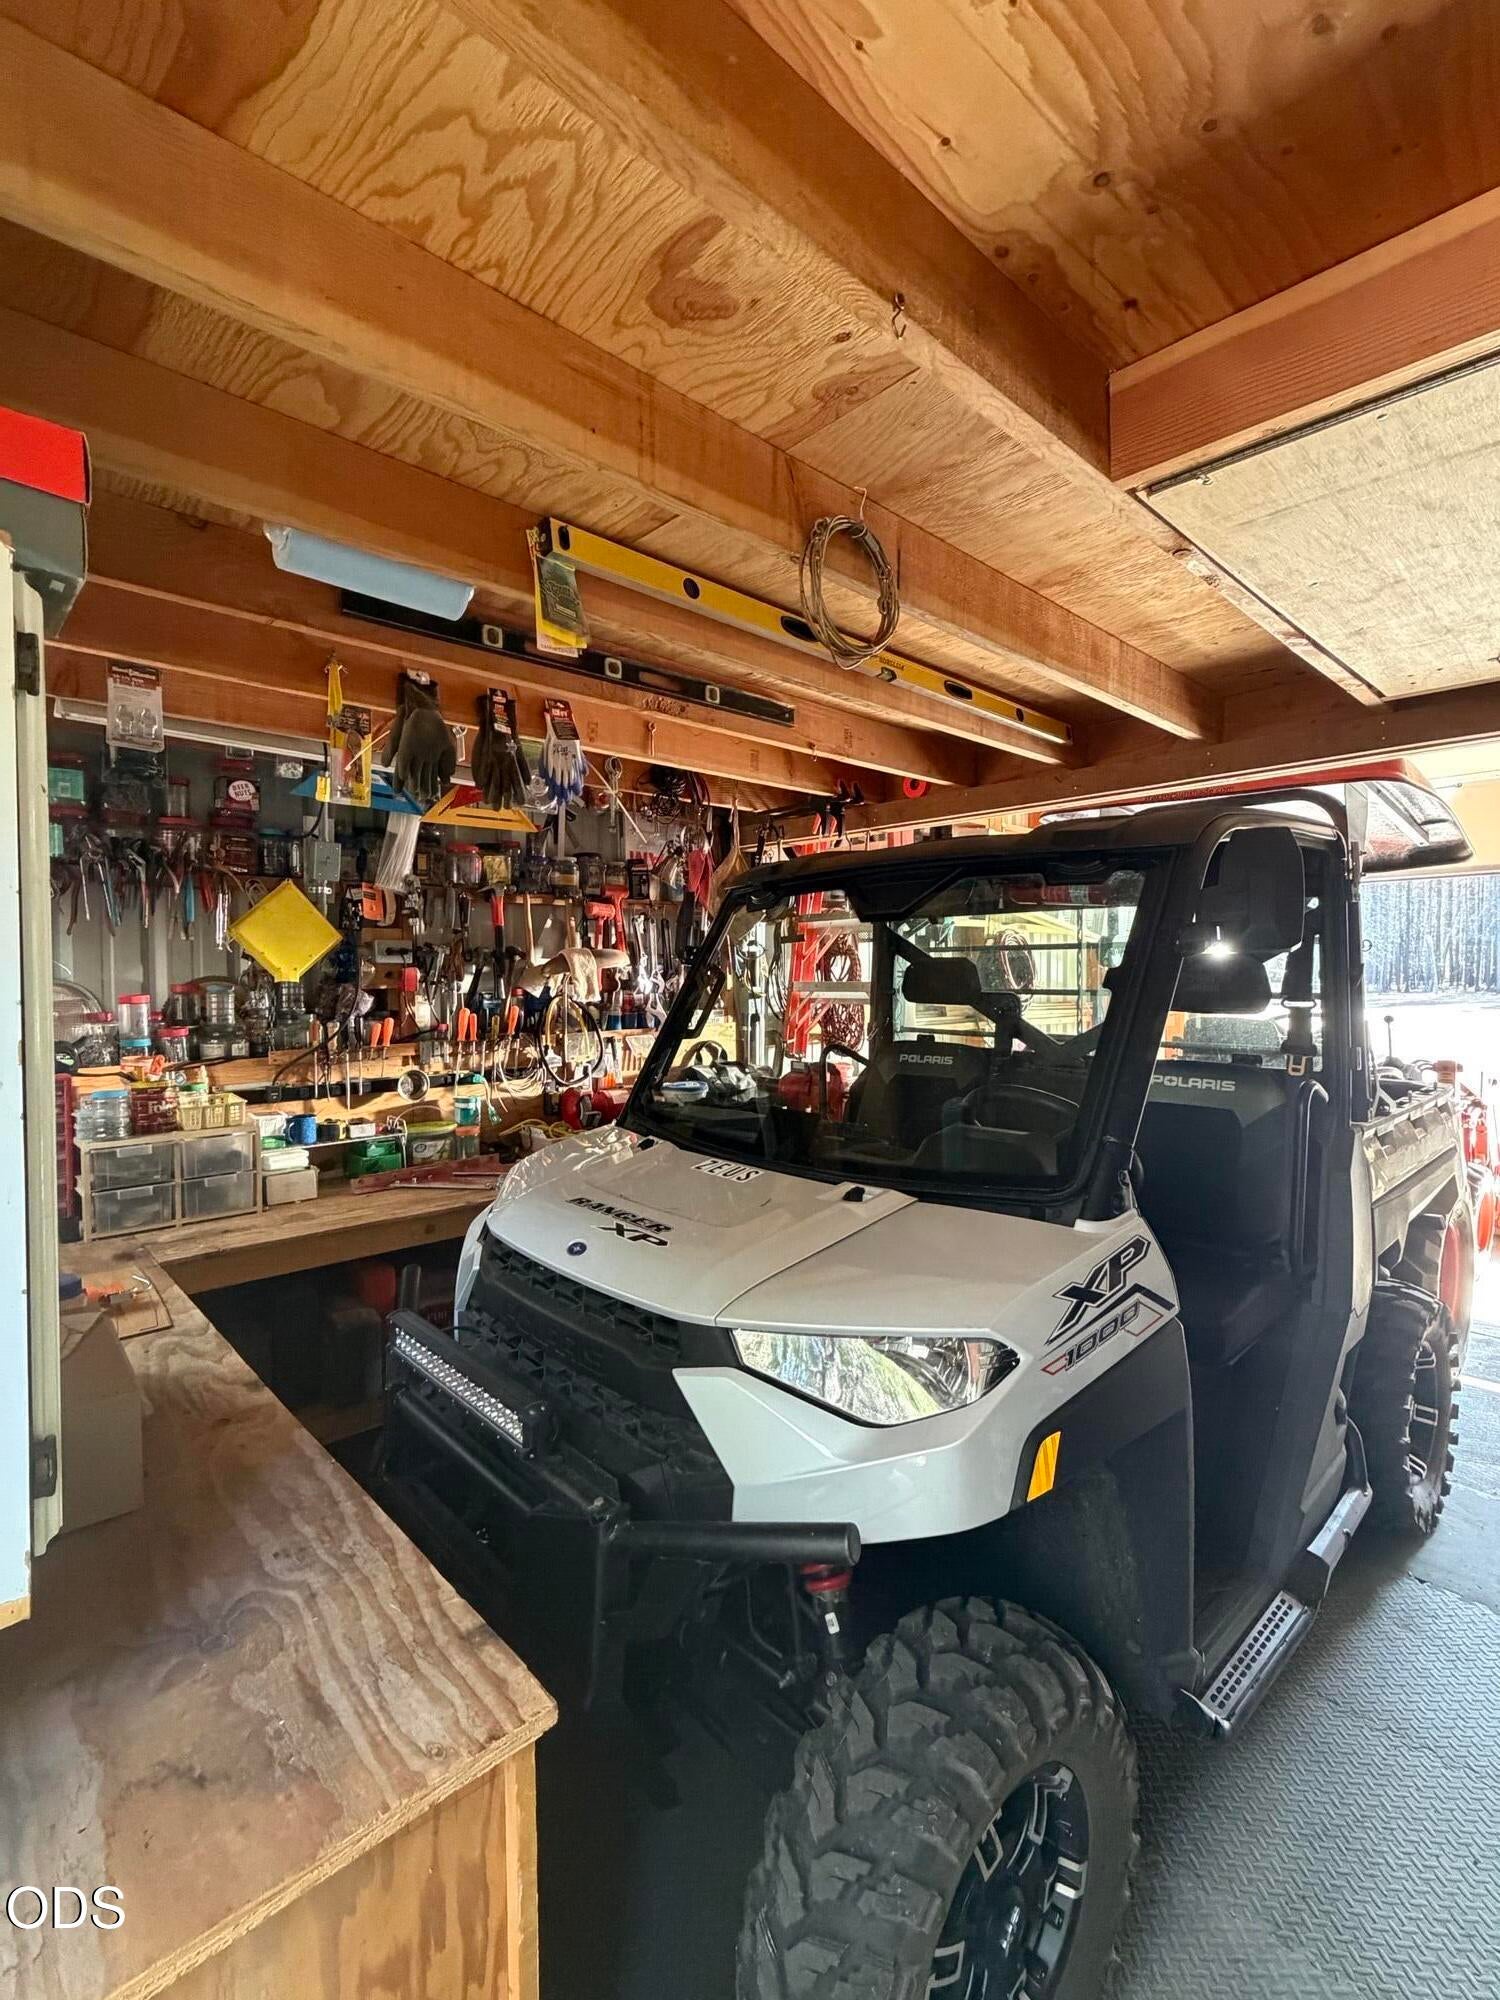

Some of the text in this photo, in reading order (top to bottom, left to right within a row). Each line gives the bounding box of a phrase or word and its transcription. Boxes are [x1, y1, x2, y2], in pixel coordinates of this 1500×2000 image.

[899, 1054, 954, 1065] POLARIS
[1152, 1075, 1236, 1092] POLARIS
[695, 1160, 759, 1182] ZEUS
[566, 1197, 673, 1234] RANGER
[595, 1221, 671, 1247] XP
[1045, 1234, 1151, 1345] XP
[1065, 1299, 1141, 1371] 1000
